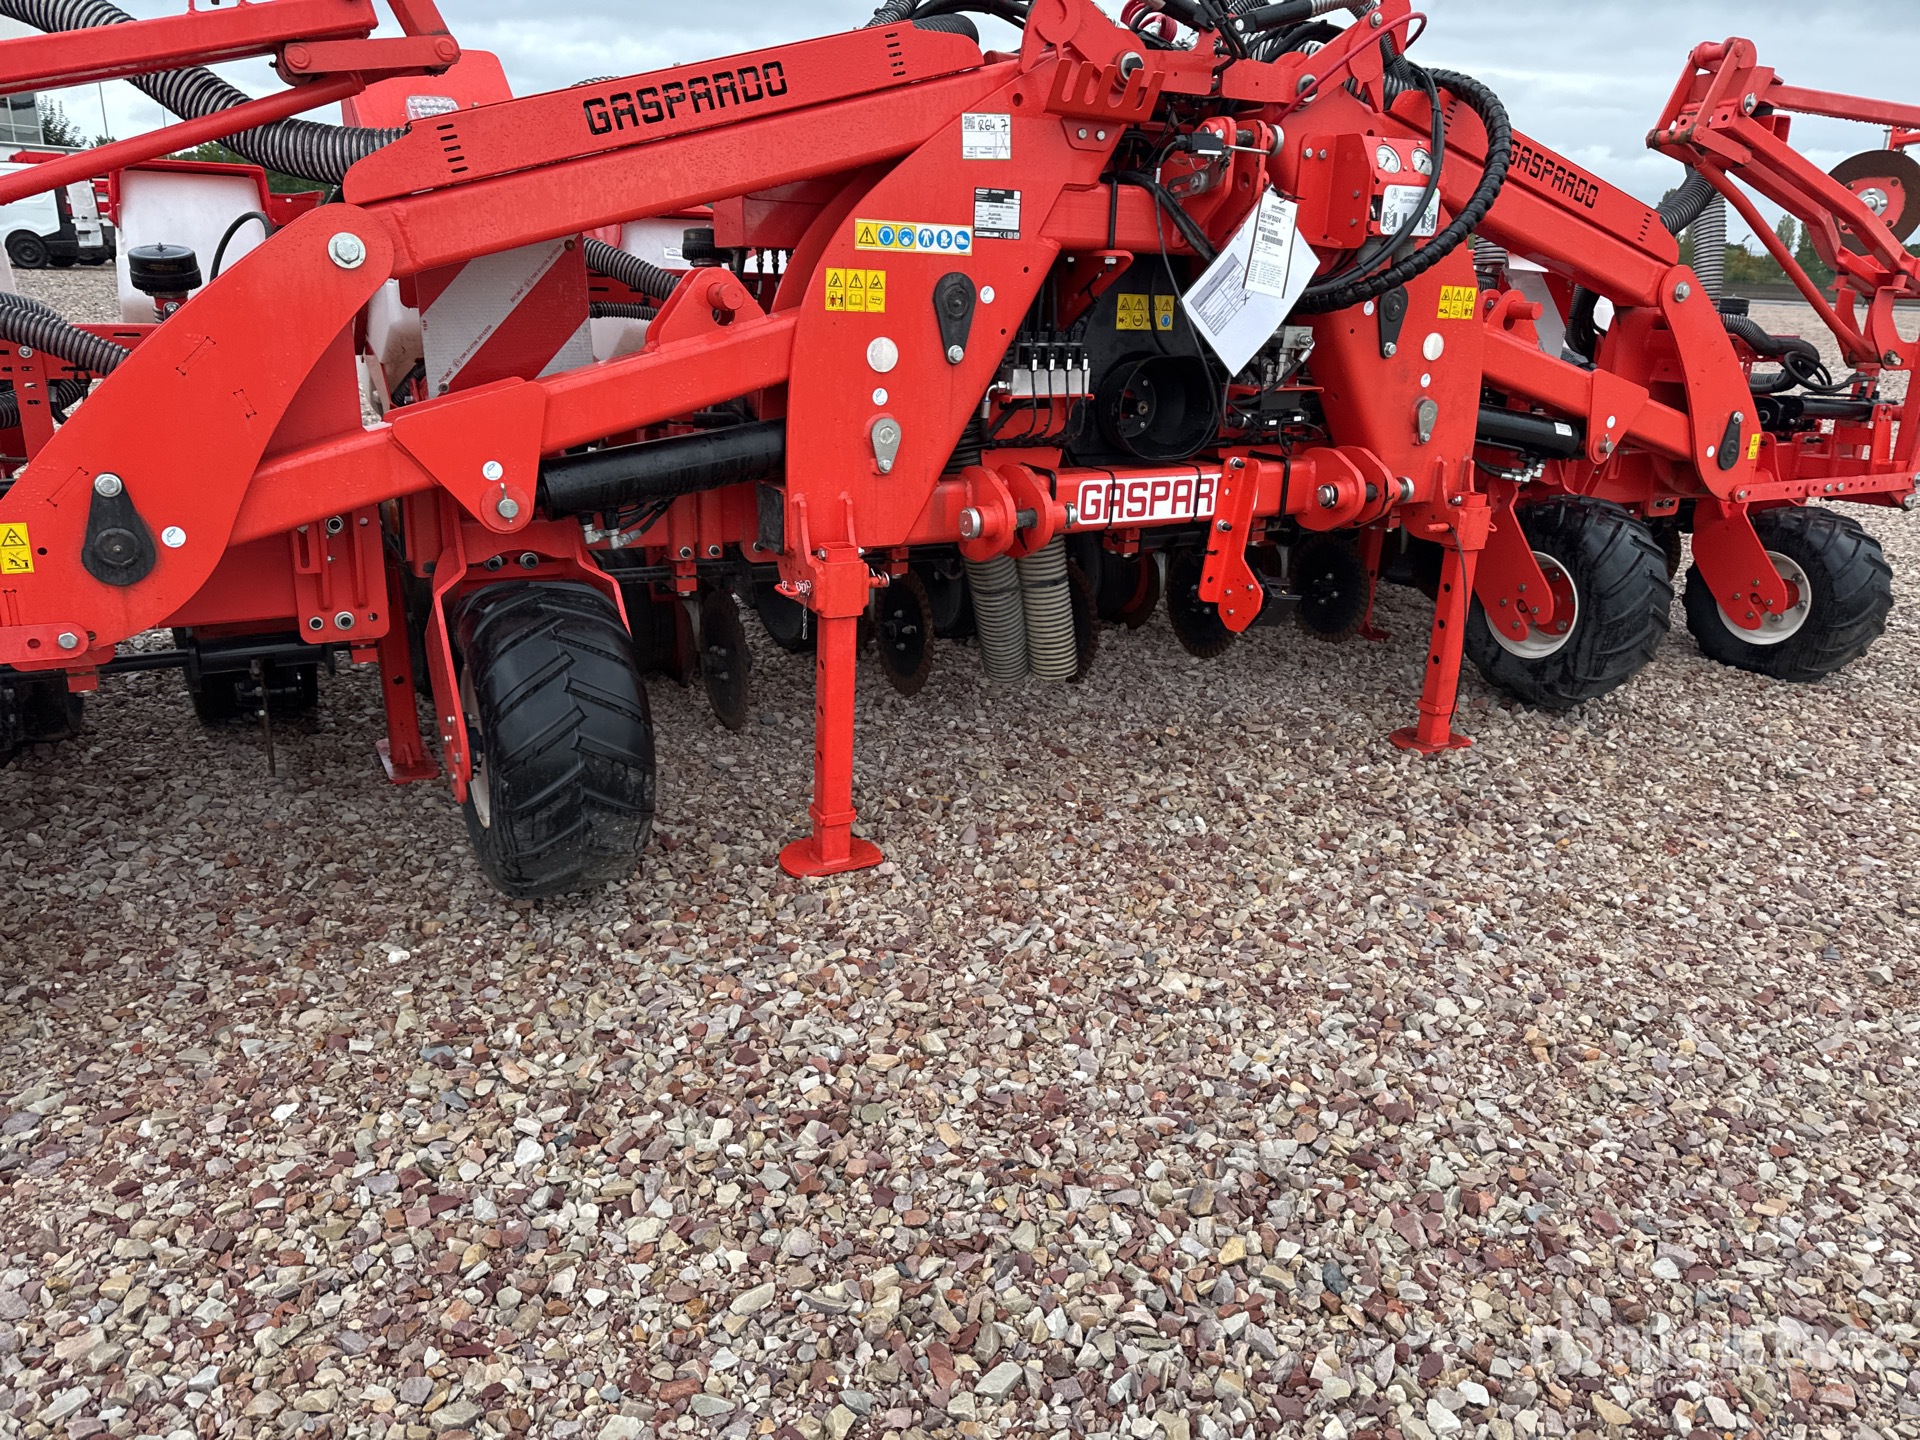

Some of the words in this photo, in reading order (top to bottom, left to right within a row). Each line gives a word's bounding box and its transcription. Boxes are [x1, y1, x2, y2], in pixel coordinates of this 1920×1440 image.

[583, 60, 788, 135] GASPARDO
[1508, 139, 1599, 209] GASPARDO
[1080, 478, 1221, 521] GASPAR
